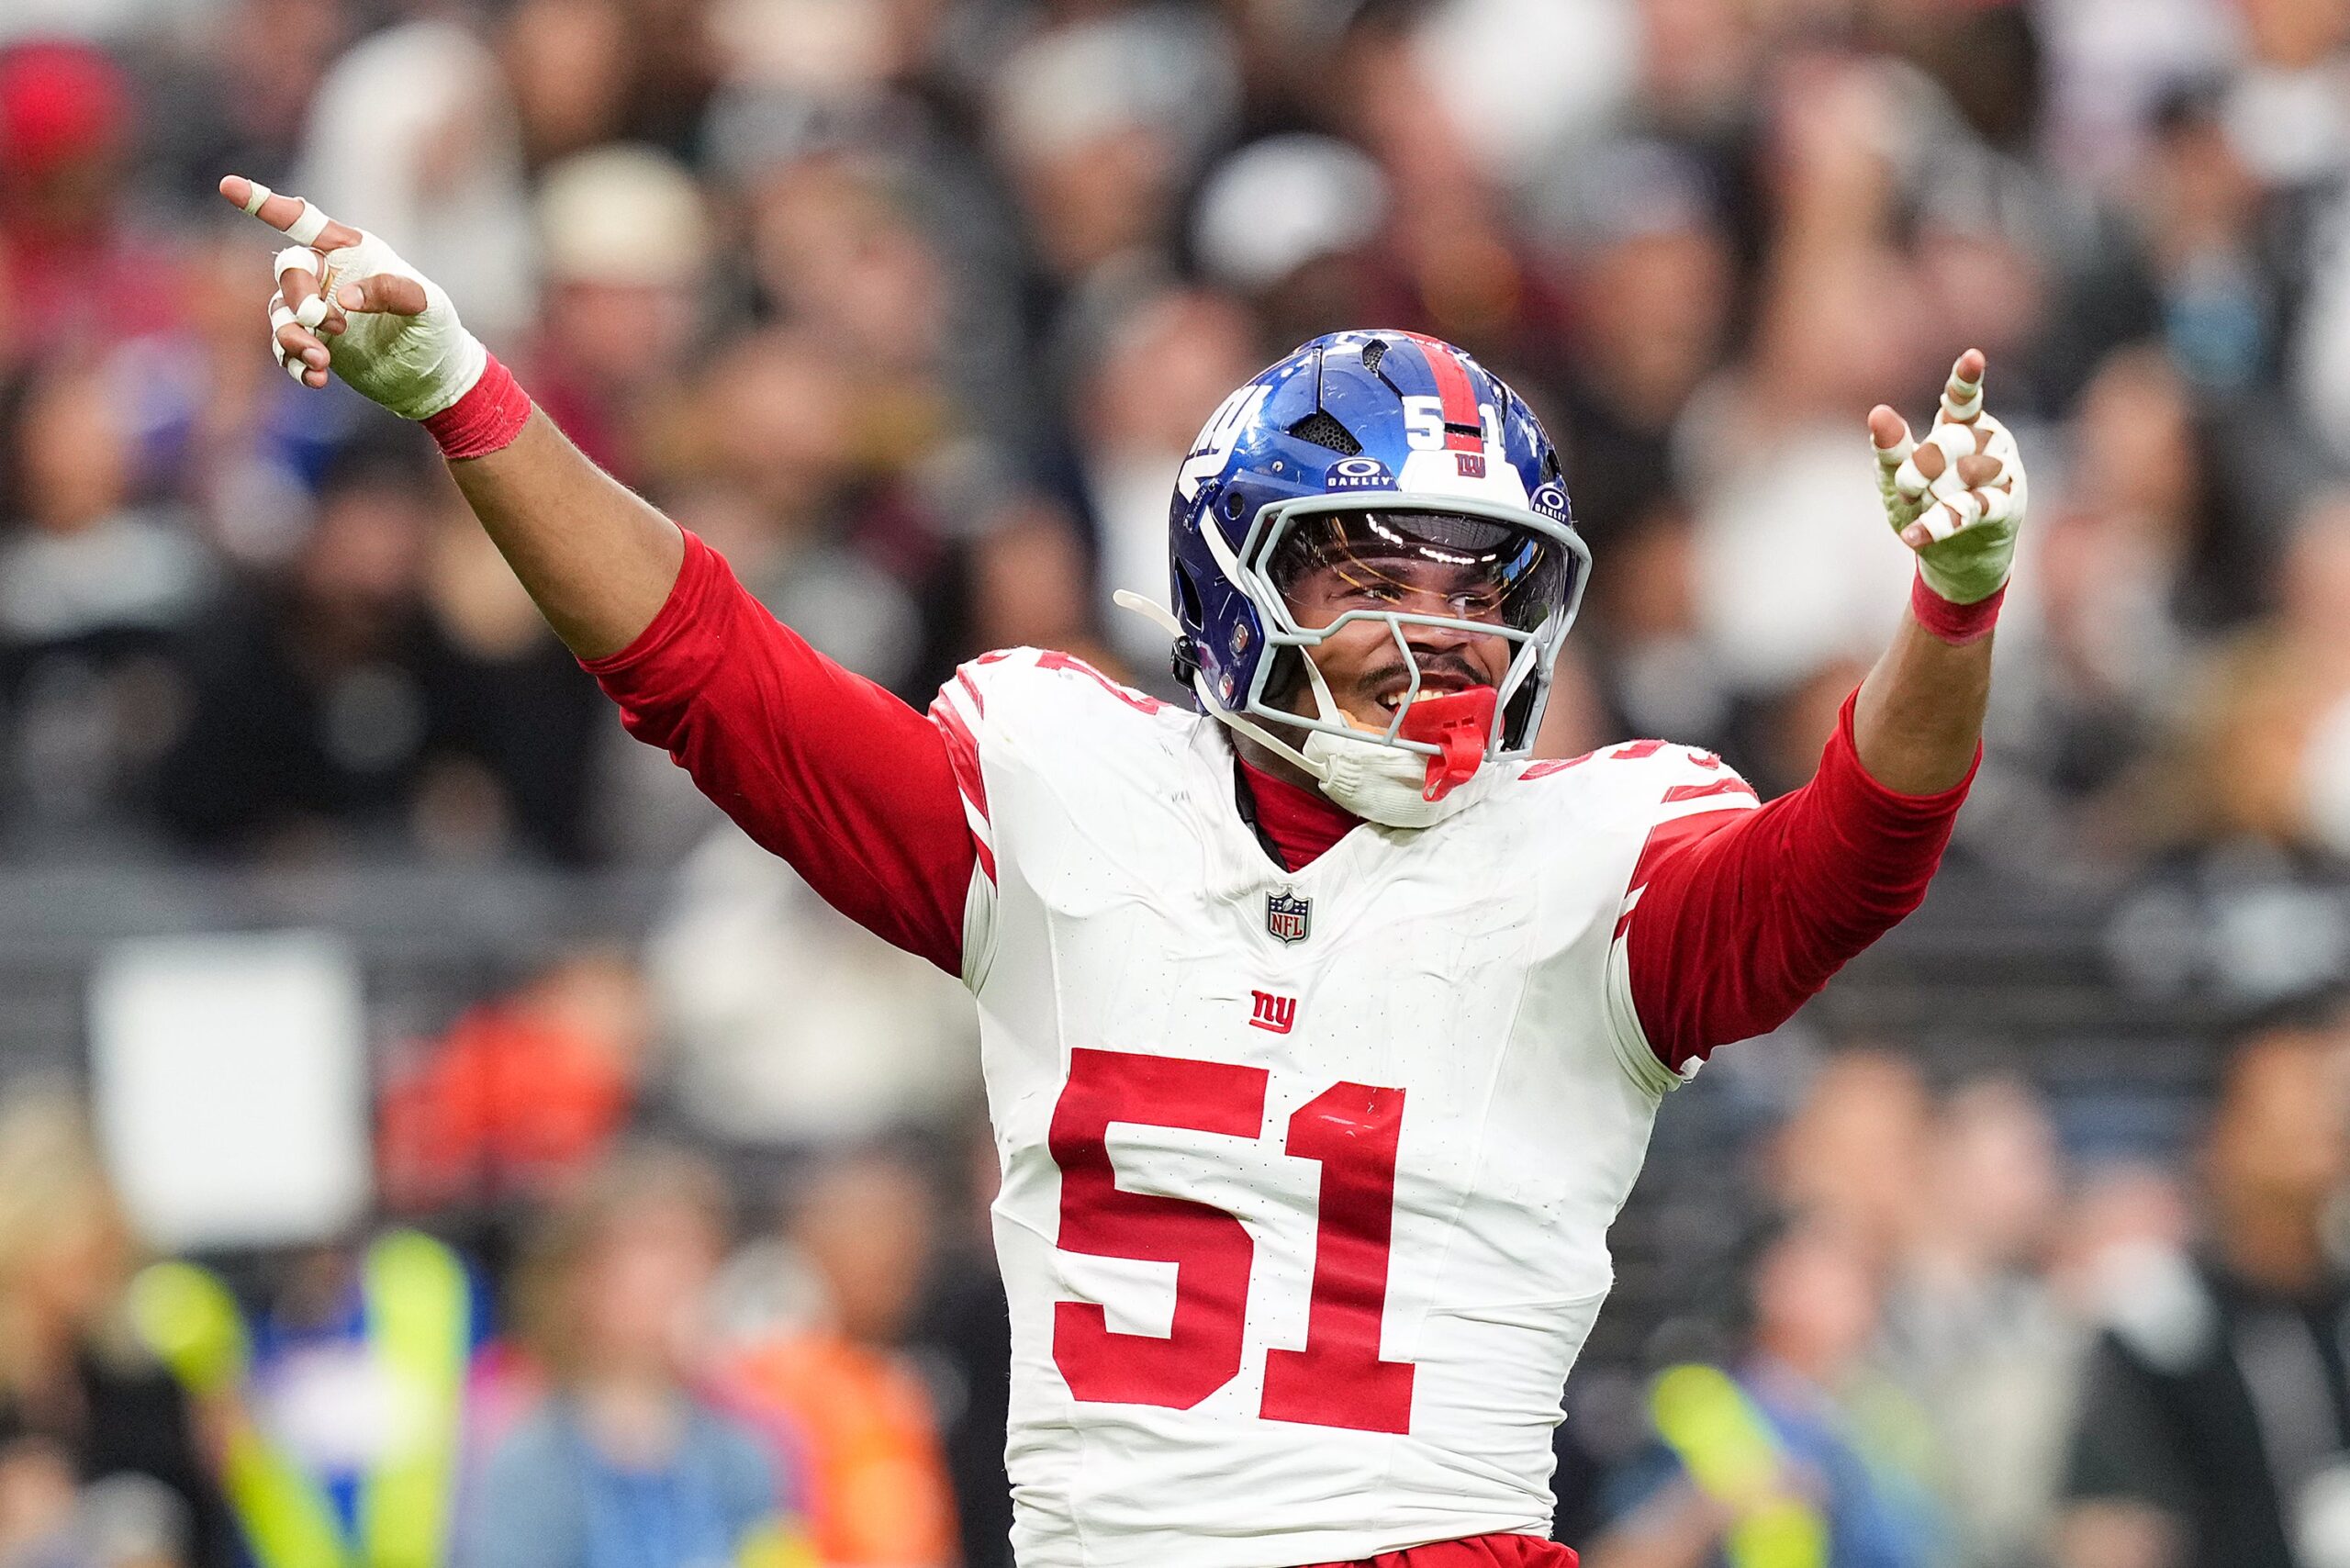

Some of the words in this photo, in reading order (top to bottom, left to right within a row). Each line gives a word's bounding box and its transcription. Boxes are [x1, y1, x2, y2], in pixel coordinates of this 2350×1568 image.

[1401, 396, 1505, 454] 51
[1327, 476, 1390, 487] OAKLEY
[1534, 503, 1567, 522] OAKLEY
[1270, 913, 1303, 937] NFL
[1248, 990, 1296, 1034] ny
[1048, 1047, 1415, 1435] 51
